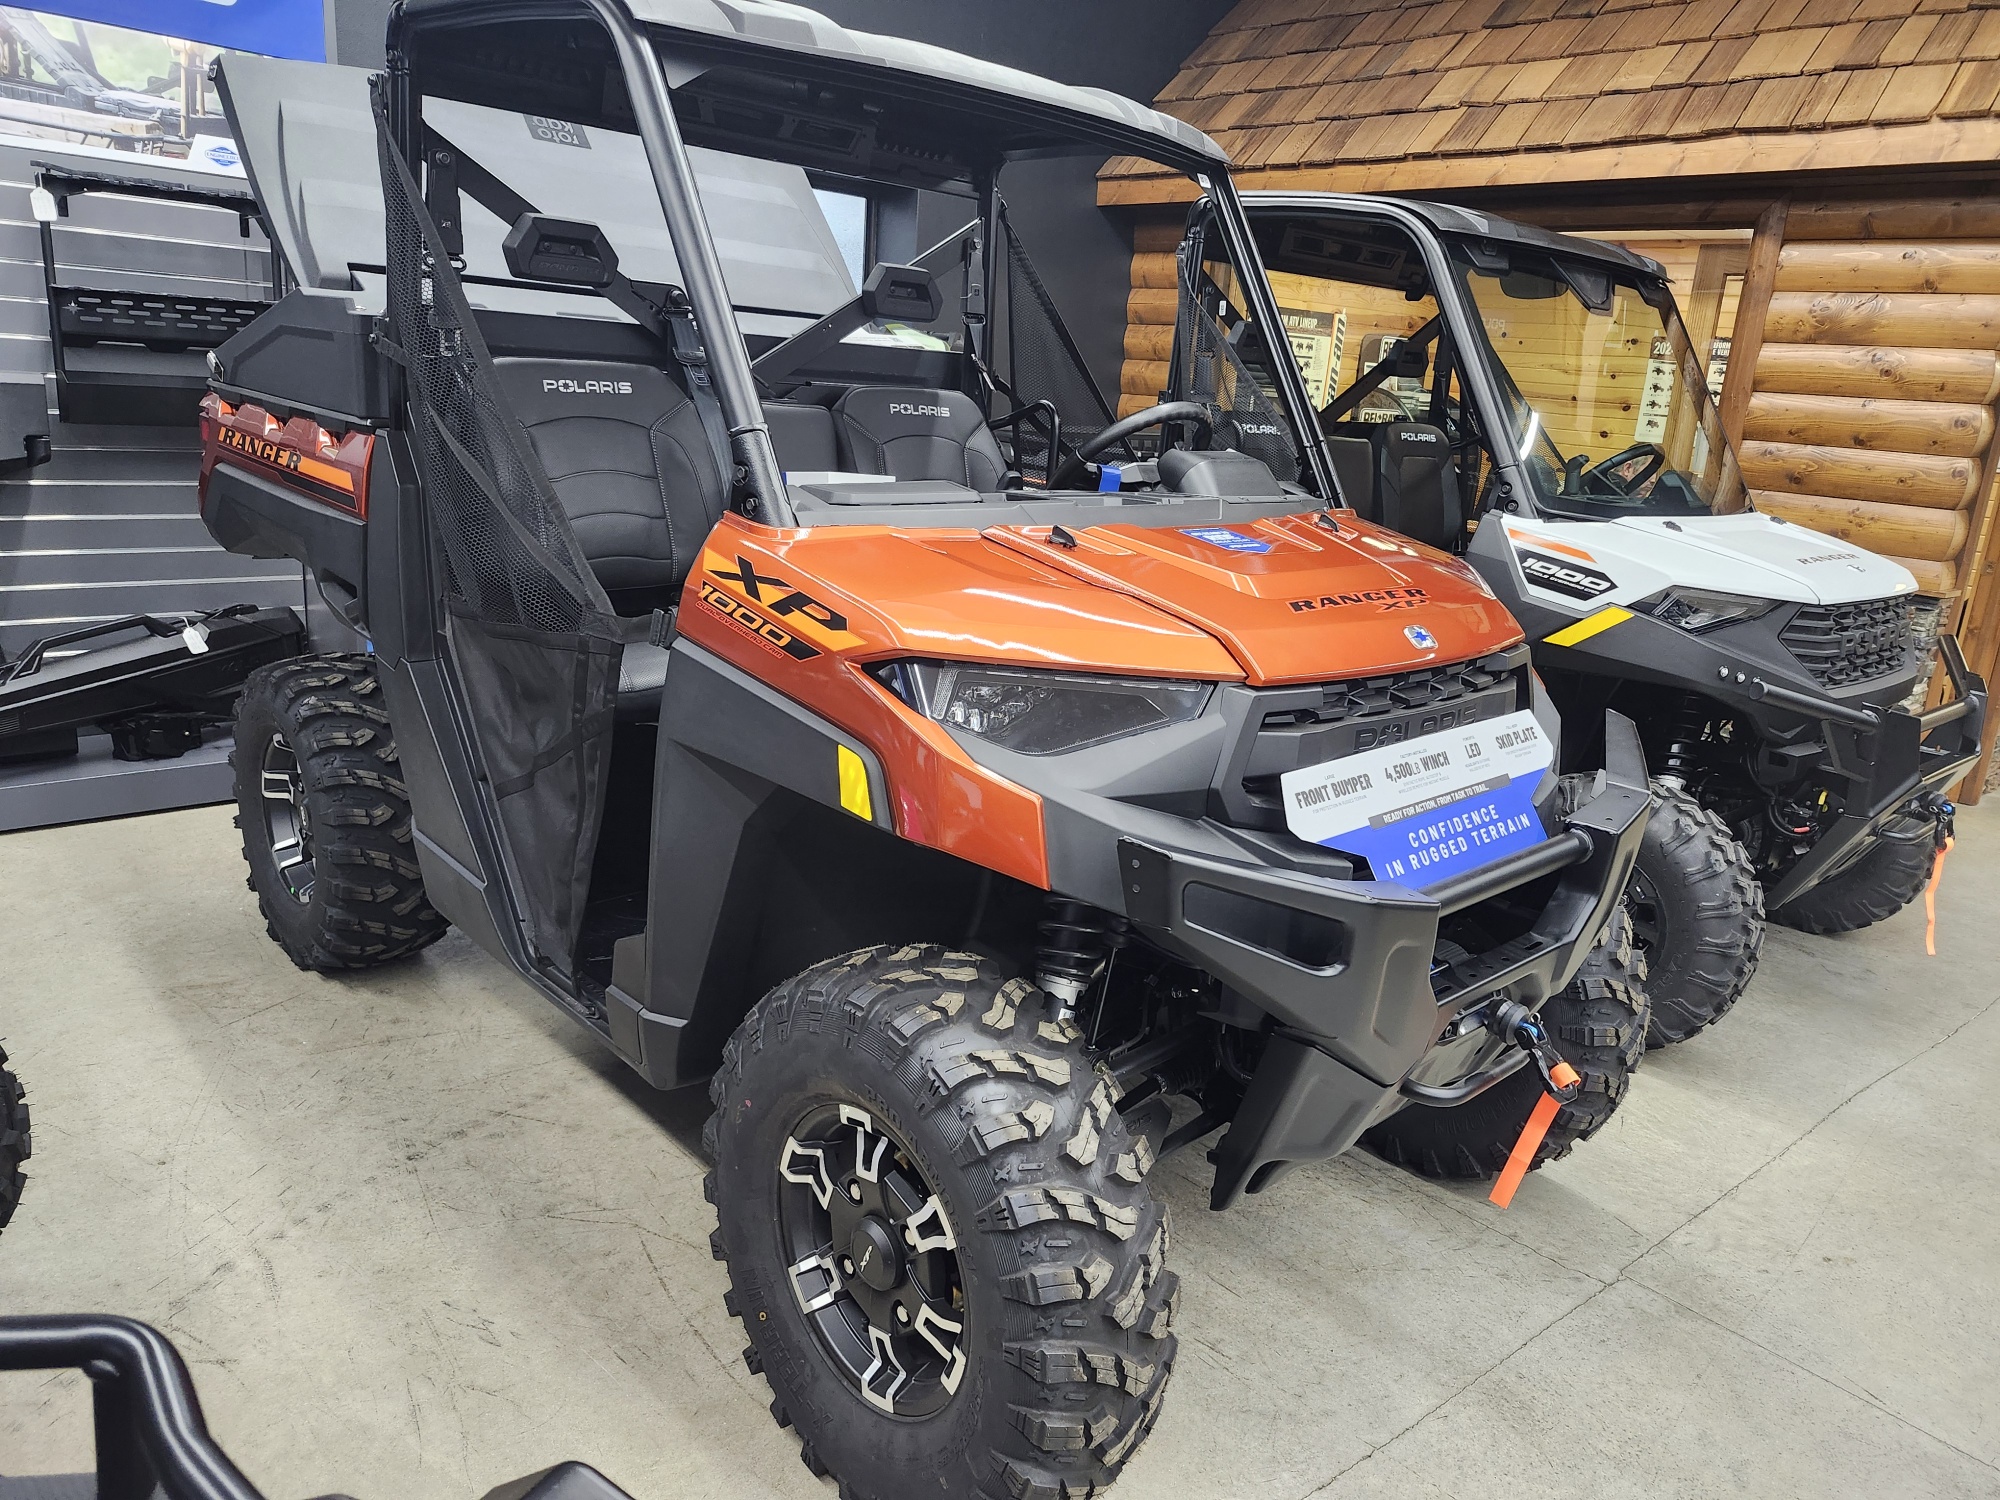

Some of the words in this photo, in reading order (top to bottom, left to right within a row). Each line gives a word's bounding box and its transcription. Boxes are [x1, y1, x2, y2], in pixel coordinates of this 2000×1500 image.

[1653, 341, 1673, 355] 202
[542, 379, 633, 394] POLARIS
[889, 403, 950, 418] POLARIS
[222, 426, 302, 472] RANGER
[1400, 432, 1437, 443] POLARIS
[1796, 553, 1860, 565] RANGER
[1521, 557, 1611, 591] 1000
[706, 553, 848, 632] XP
[1288, 588, 1428, 613] RANGER
[1377, 599, 1428, 612] XP
[698, 585, 792, 647] 1000
[763, 643, 784, 658] CAM
[1353, 704, 1478, 752] POLARIS
[1495, 733, 1515, 750] SKID
[1512, 726, 1538, 746] PLATE
[1464, 742, 1482, 759] LED
[1384, 761, 1421, 784] 4,500LB
[1419, 750, 1451, 772] WINCH
[1294, 784, 1331, 809] FRONT
[1330, 773, 1373, 799] BUMPER
[1382, 810, 1404, 824] READY
[1403, 807, 1416, 818] FOR
[1415, 799, 1438, 813] ACTION,
[1436, 796, 1453, 807] FROM
[1452, 791, 1466, 802] TASK
[1465, 787, 1474, 797] TO
[1408, 804, 1500, 848] CONFIDENCE
[1385, 859, 1405, 879] IN
[1408, 837, 1468, 870] RUGGED
[1471, 813, 1531, 847] TERRAIN
